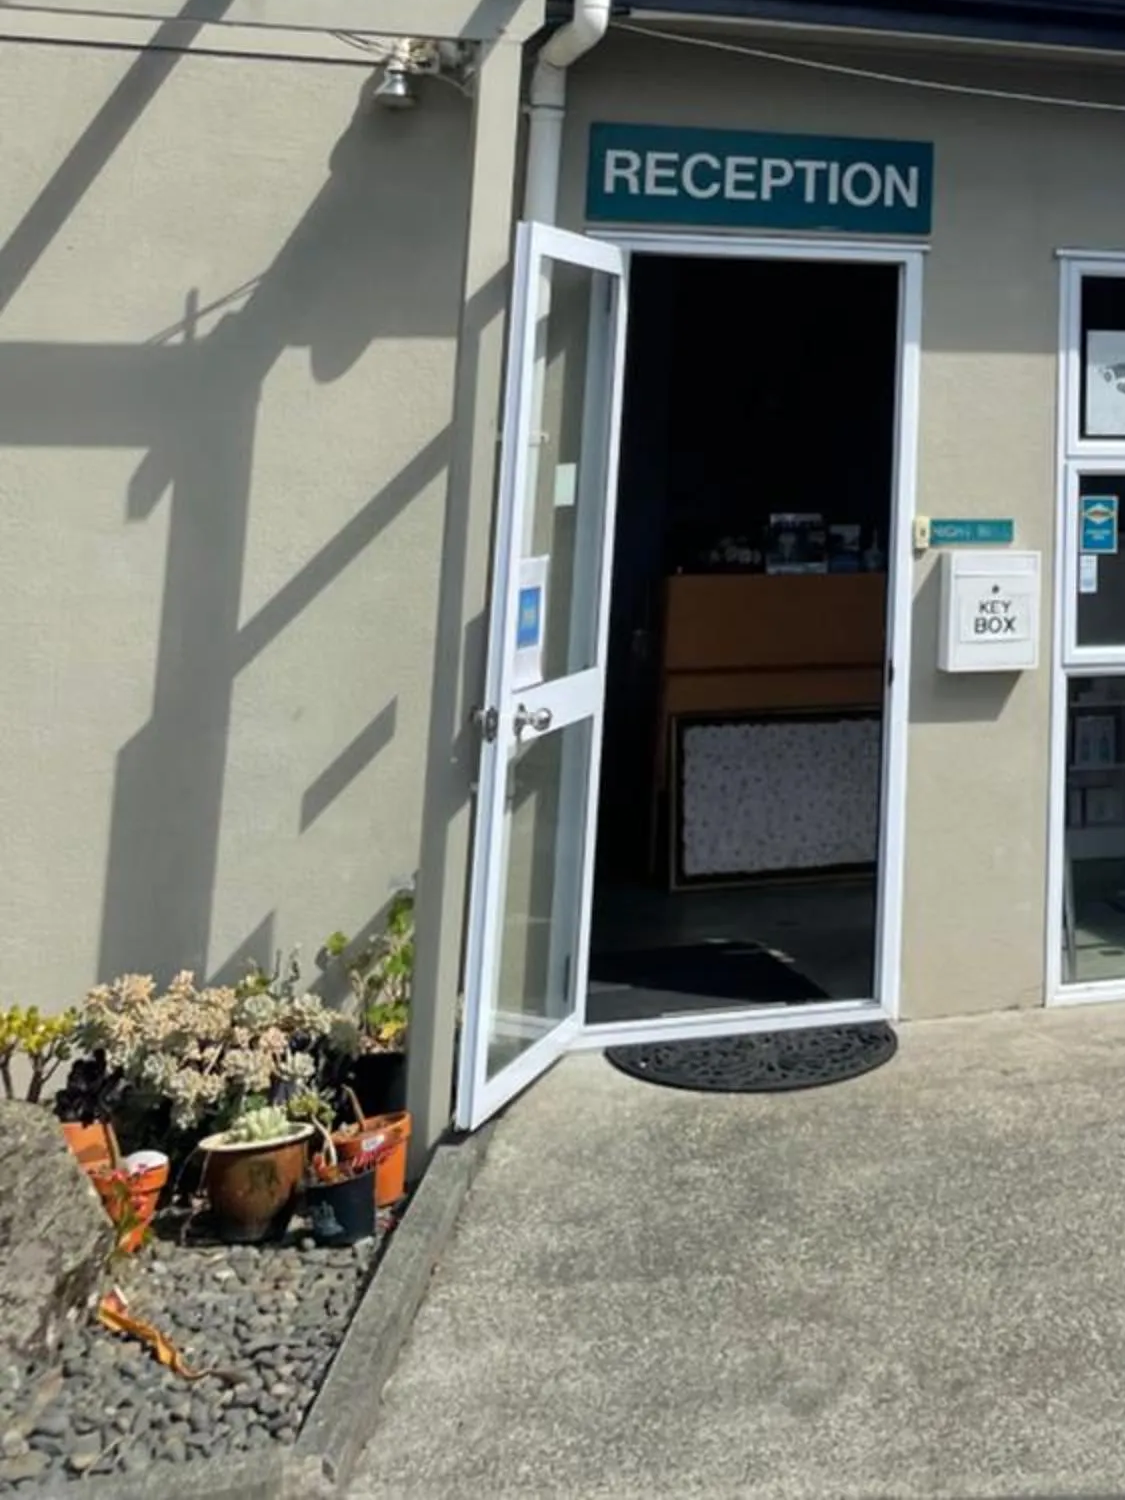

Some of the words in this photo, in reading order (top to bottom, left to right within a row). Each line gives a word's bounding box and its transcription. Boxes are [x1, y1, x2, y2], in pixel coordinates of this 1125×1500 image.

[604, 149, 919, 208] RECEPTION
[979, 600, 1011, 614] KEY
[974, 617, 1016, 634] BOX
